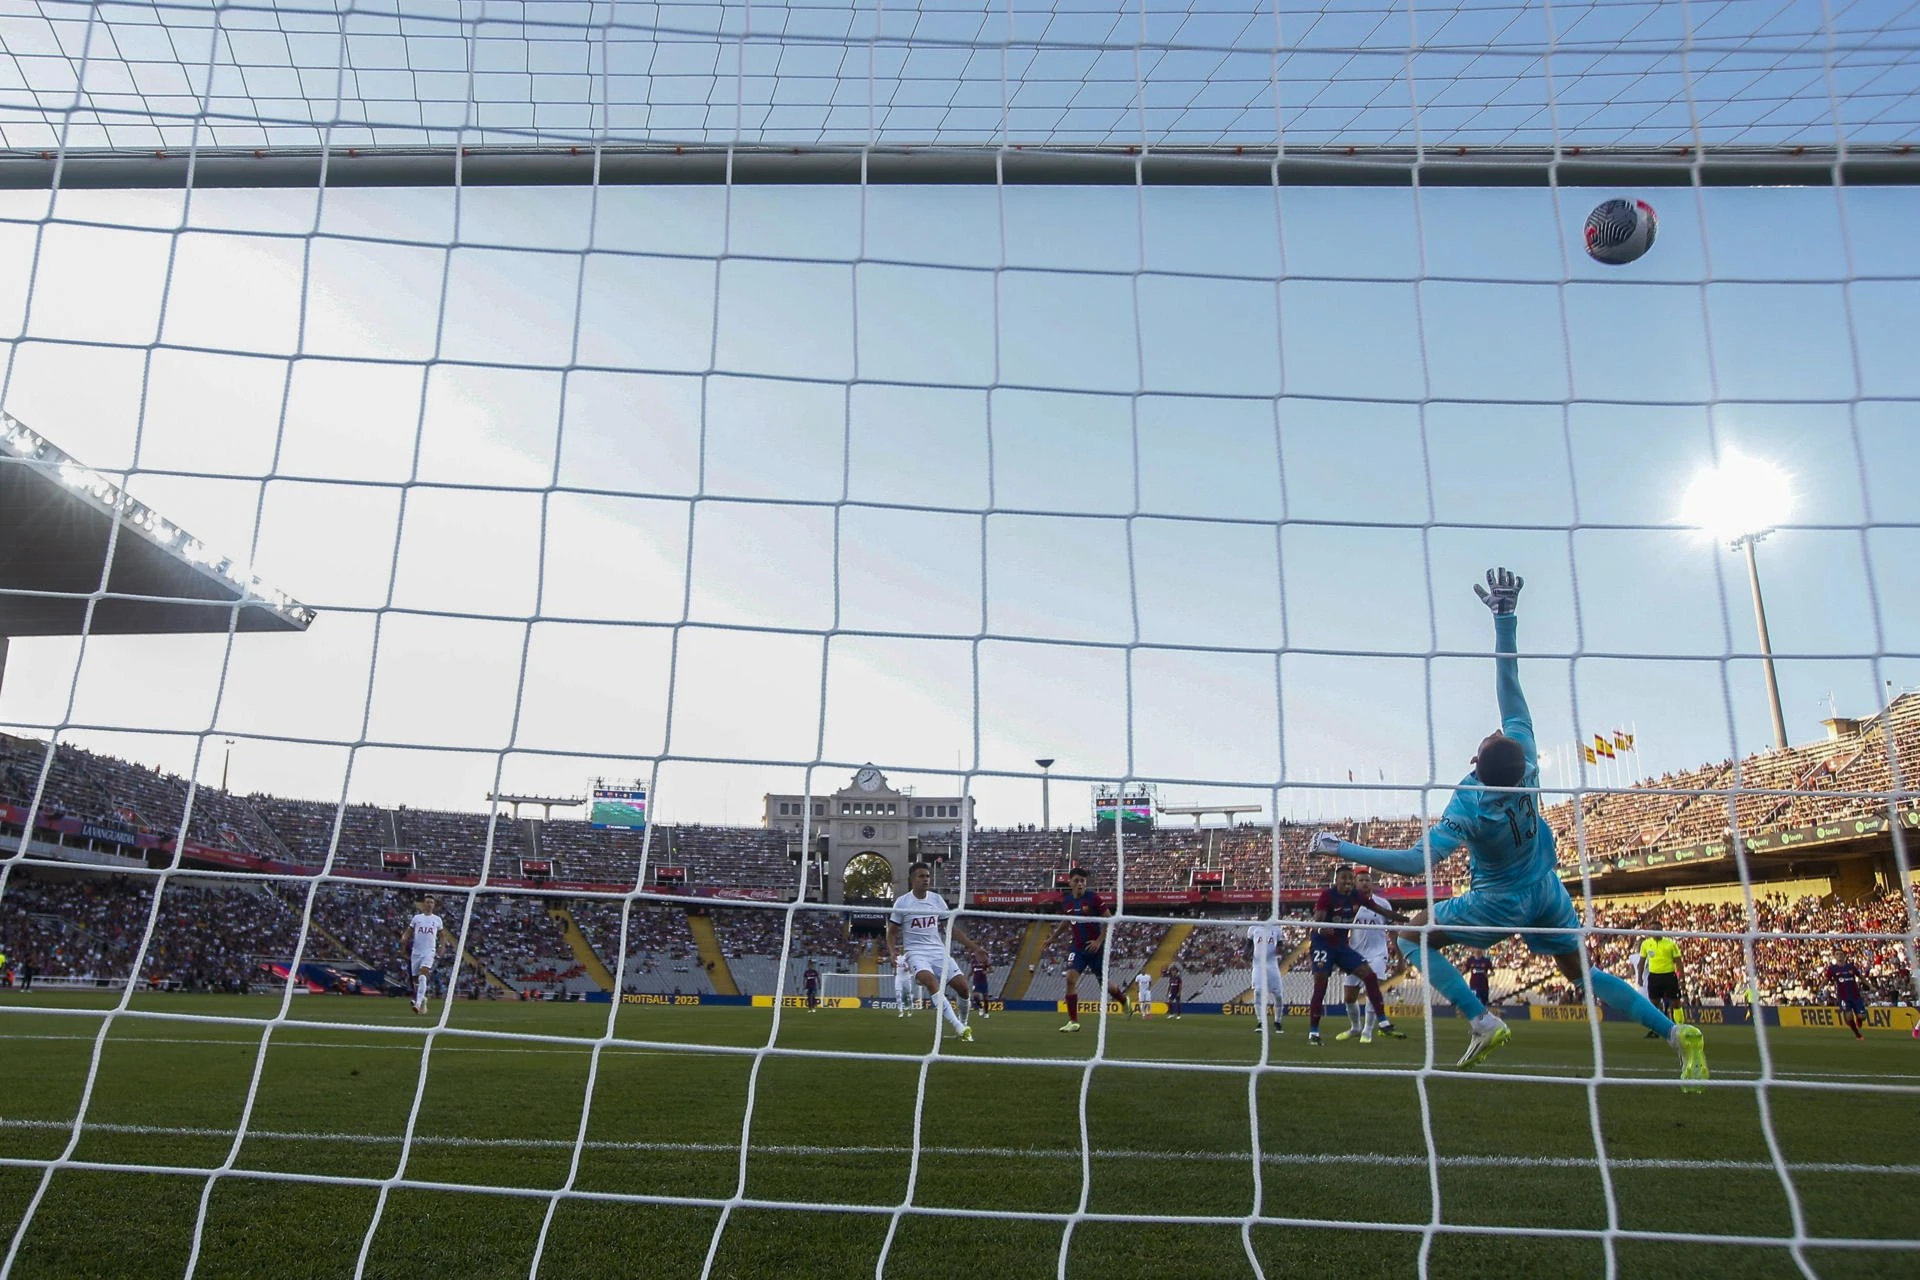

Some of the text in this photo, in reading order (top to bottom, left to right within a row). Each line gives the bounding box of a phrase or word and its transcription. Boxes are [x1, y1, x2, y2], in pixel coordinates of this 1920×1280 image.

[1505, 794, 1538, 848] 13
[911, 916, 937, 929] AIA
[418, 926, 434, 935] AIA
[1257, 936, 1275, 945] AA
[1313, 950, 1328, 962] 22
[622, 994, 700, 1005] FOOTBALL 2023
[1541, 1007, 1558, 1019] FREE
[1698, 1008, 1724, 1024] 2023
[1800, 1007, 1834, 1027] FREE
[1863, 1008, 1891, 1028] LAY
